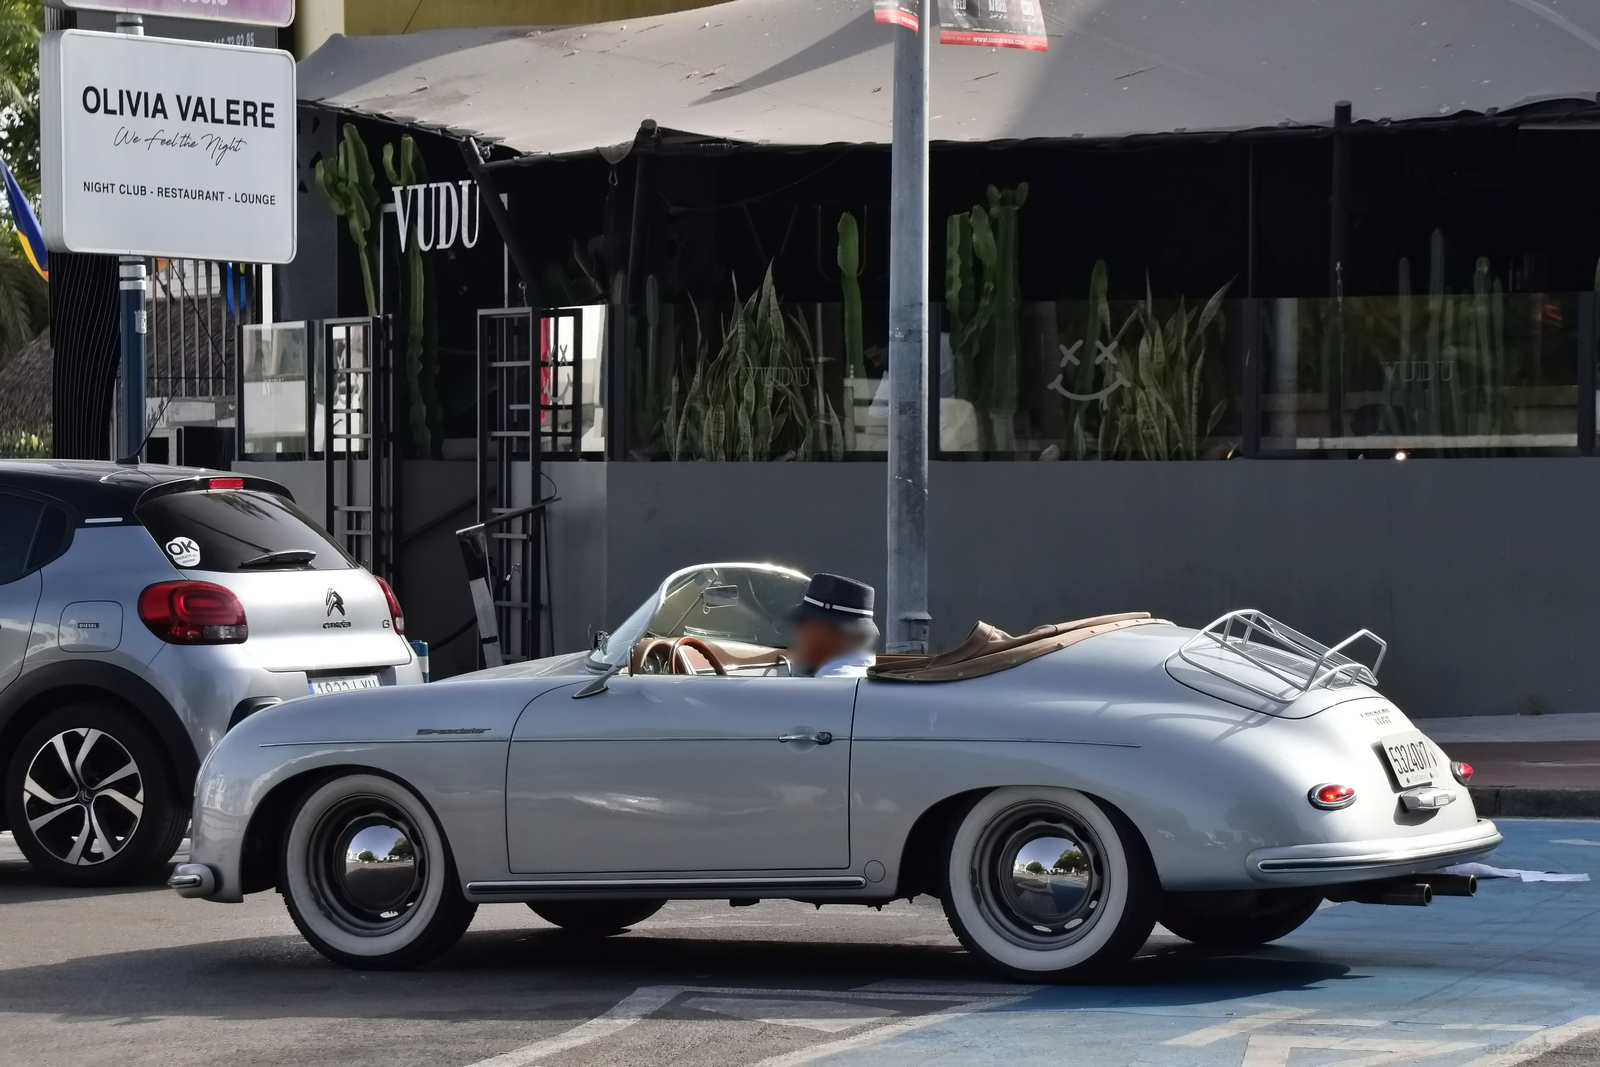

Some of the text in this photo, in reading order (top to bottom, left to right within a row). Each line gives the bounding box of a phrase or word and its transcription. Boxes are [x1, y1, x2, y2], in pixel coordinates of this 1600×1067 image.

[82, 86, 275, 128] OLIVIA VALERE
[113, 126, 247, 166] We Feel the Night
[83, 181, 276, 206] NIGHT CLUB RESTAURANT LOUNGE
[392, 180, 480, 253] VUDU
[742, 366, 811, 387] VUDU
[1381, 361, 1455, 382] VUDU
[167, 540, 198, 555] OK
